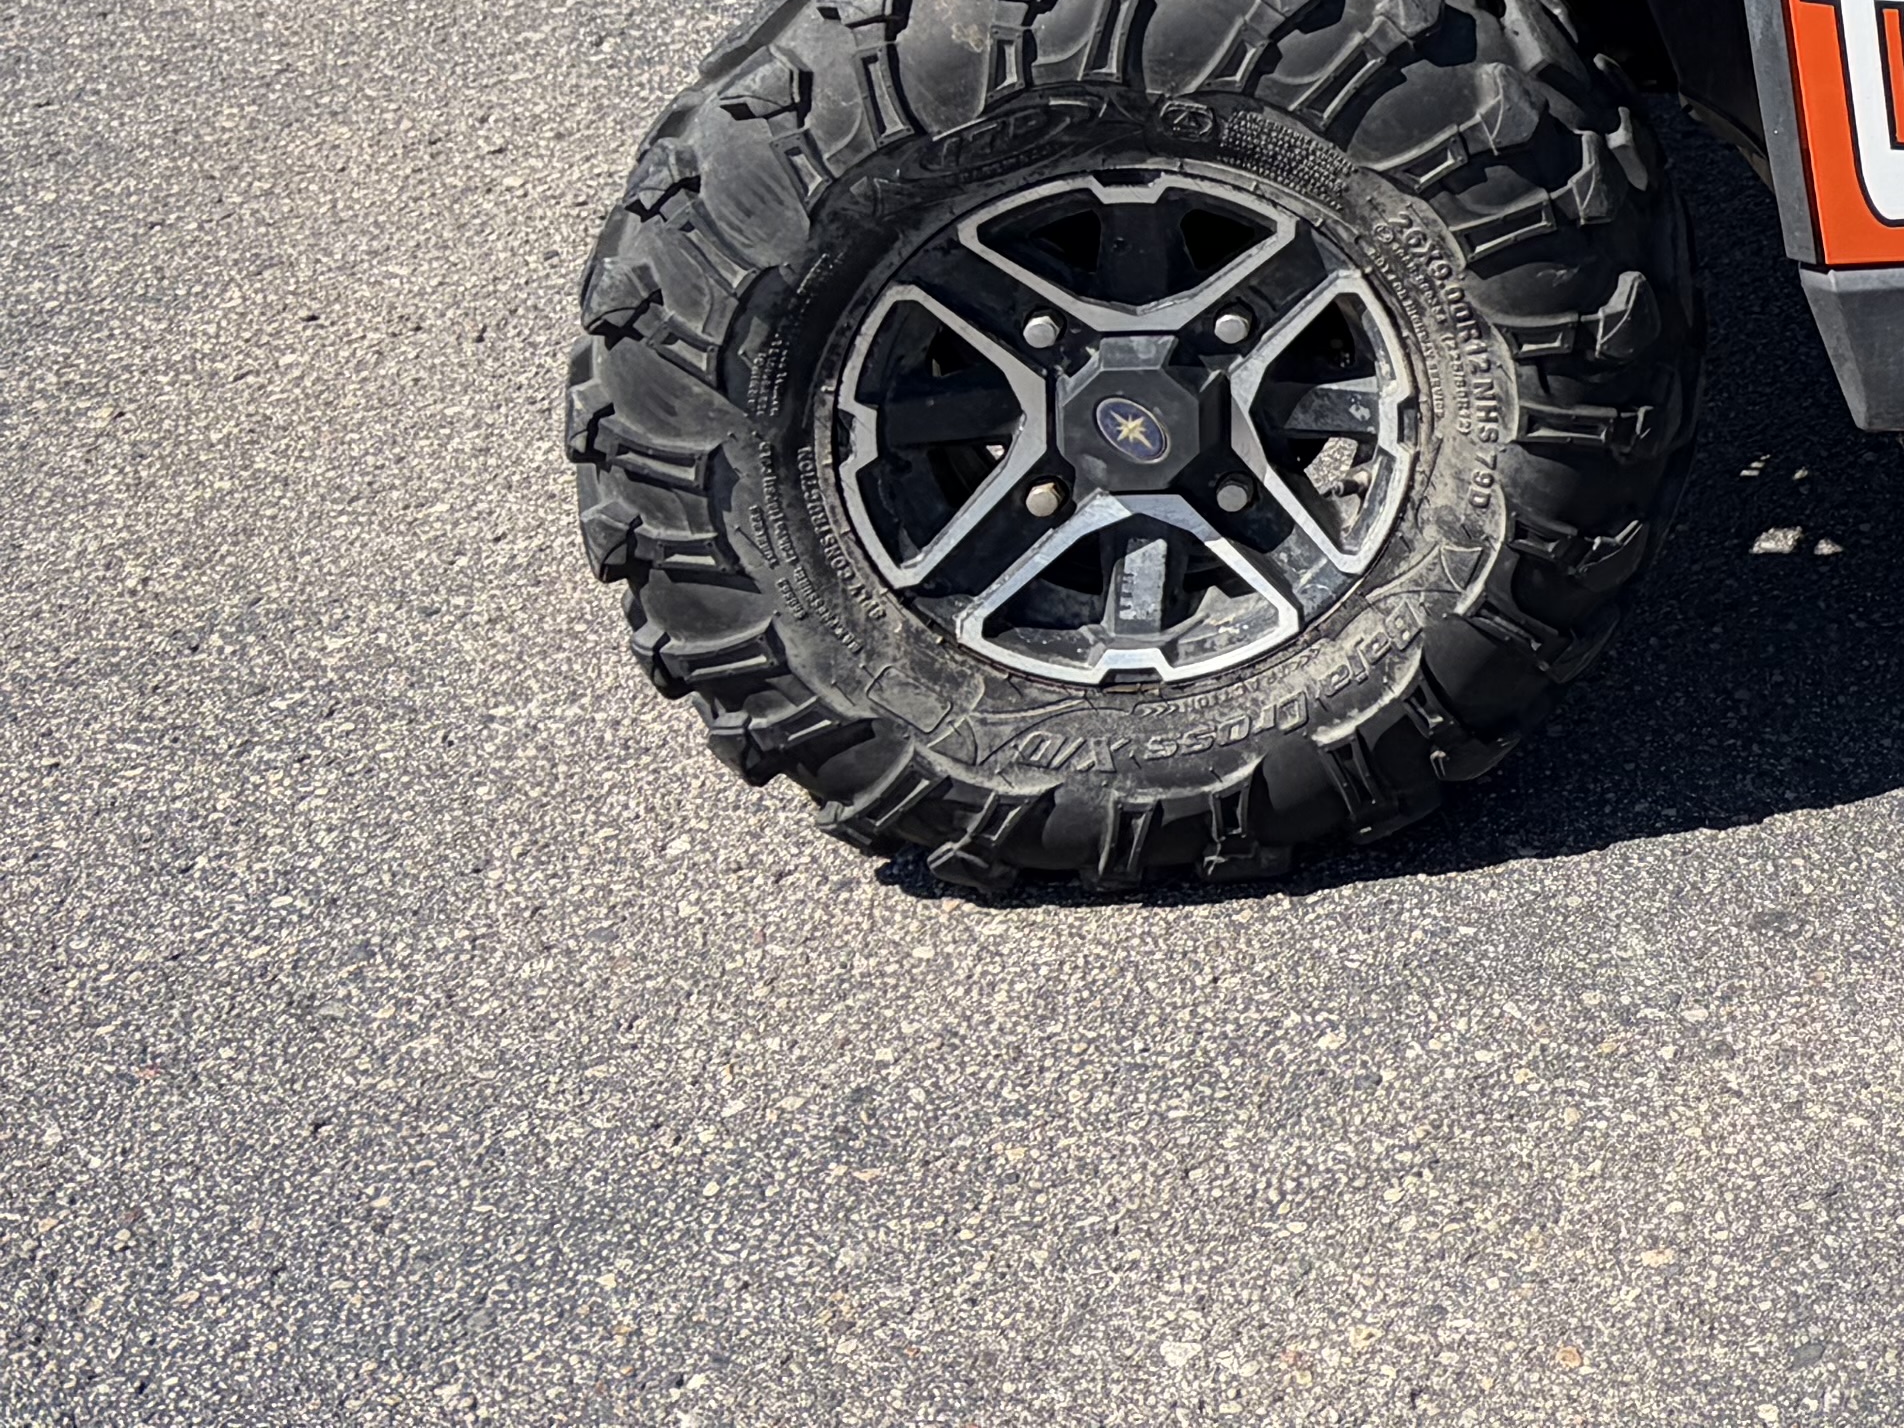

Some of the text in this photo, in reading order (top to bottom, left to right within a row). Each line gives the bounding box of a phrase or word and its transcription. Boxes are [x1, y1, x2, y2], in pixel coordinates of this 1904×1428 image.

[794, 445, 855, 583] CONSTRUCTION
[1313, 598, 1433, 709] Baja
[1142, 688, 1322, 767] Cross
